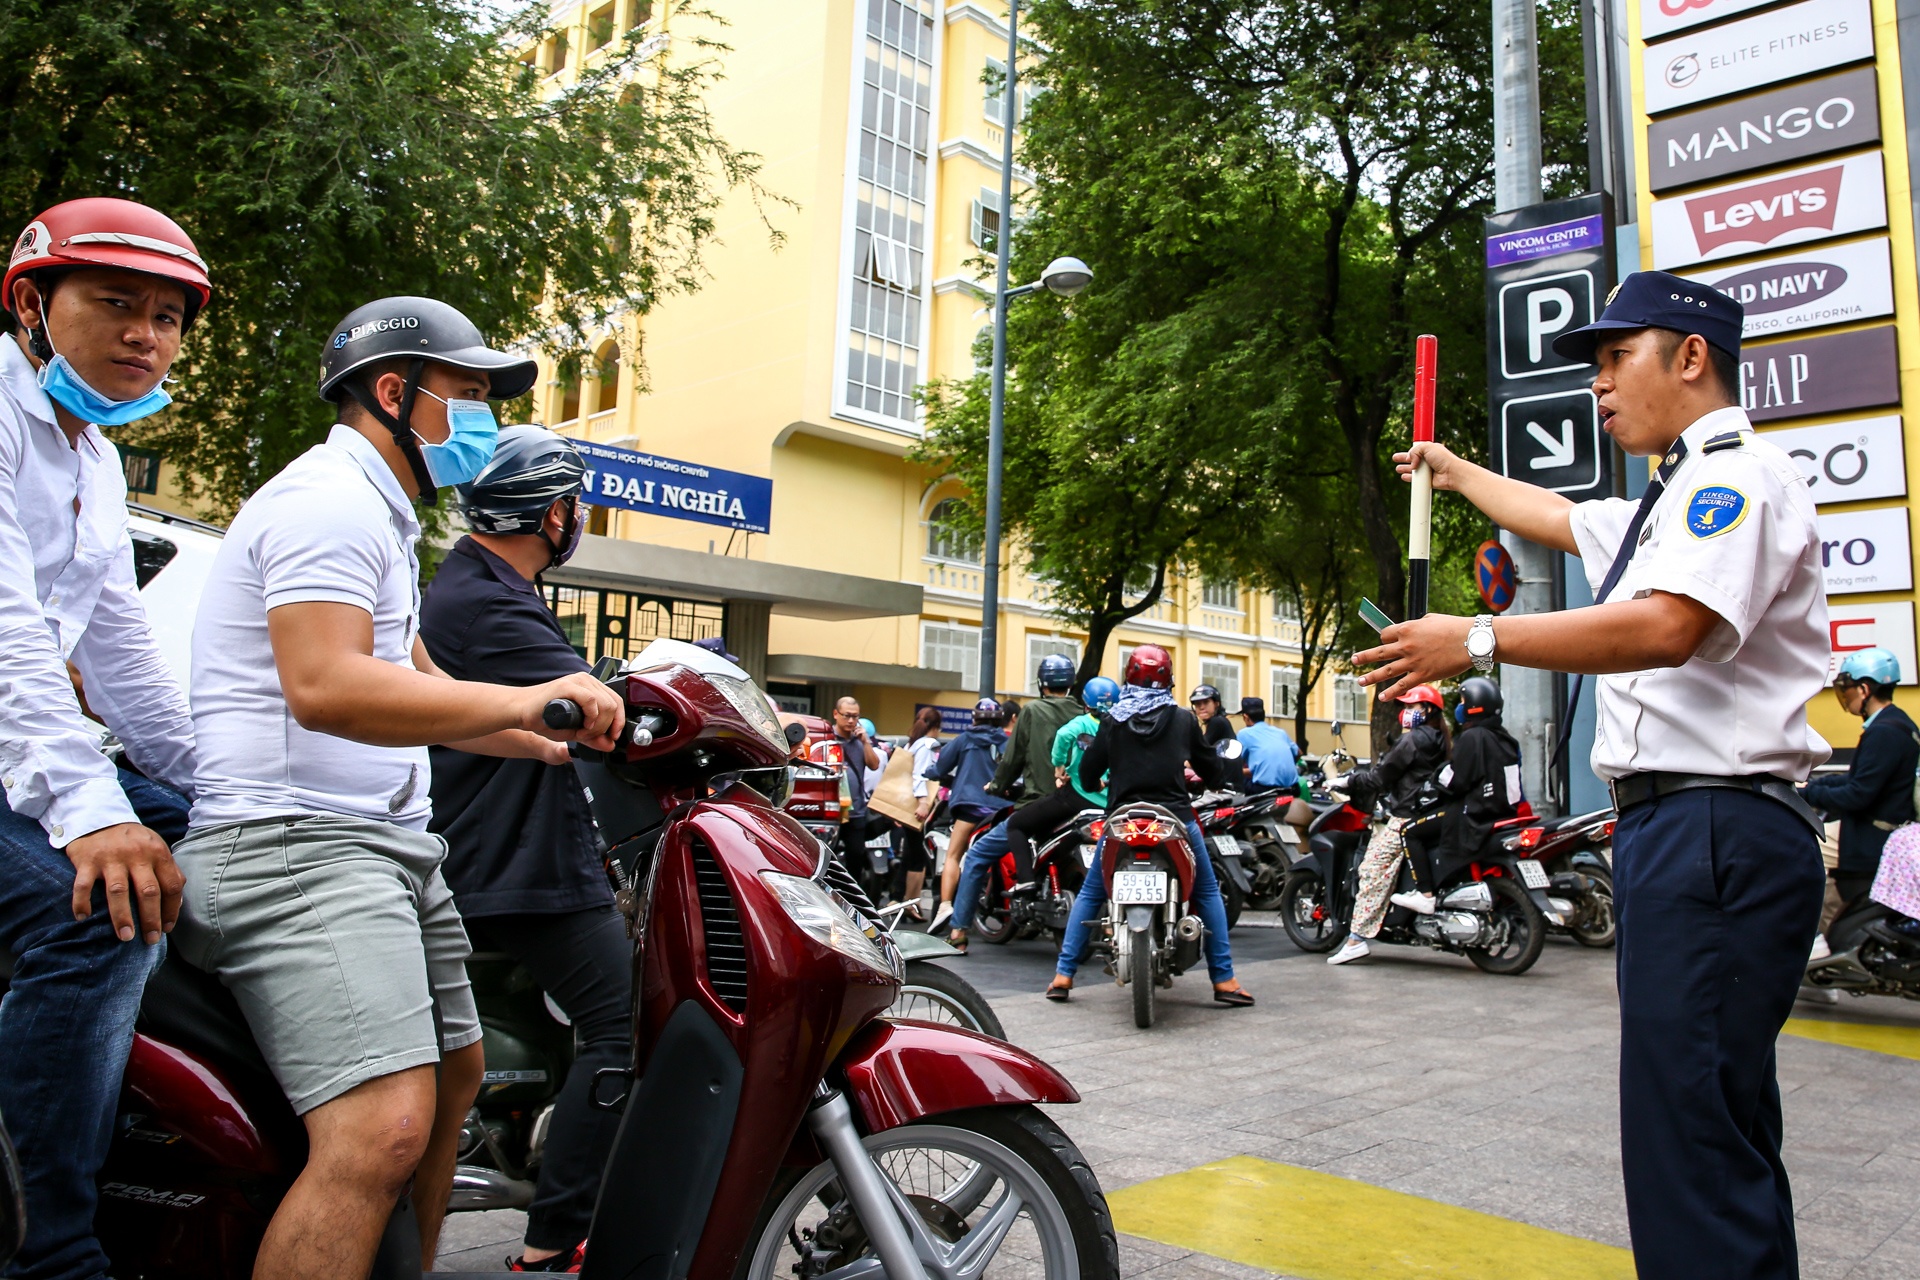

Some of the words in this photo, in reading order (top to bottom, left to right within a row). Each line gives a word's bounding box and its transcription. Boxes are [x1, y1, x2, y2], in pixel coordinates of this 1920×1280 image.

[1710, 45, 1760, 69] ELITE
[1769, 21, 1849, 53] FITNESS
[1668, 97, 1855, 167] MANGO
[1499, 235, 1545, 252] VINCOM
[1546, 226, 1589, 244] CENTER
[1761, 269, 1828, 300] NAVY
[1527, 287, 1574, 364] P
[1786, 305, 1862, 325] CALIFORNIA
[350, 317, 419, 340] PIAGGIO
[1739, 353, 1809, 412] GAP
[591, 447, 618, 460] TRUNG
[618, 453, 636, 464] HỌC
[602, 472, 656, 506] ĐẠI
[660, 484, 746, 521] NGHĨA
[1697, 499, 1735, 509] SECURITY
[1702, 492, 1738, 501] VINCOM
[486, 1071, 517, 1080] CUB
[103, 1190, 132, 1199] FUEL
[133, 1195, 192, 1208] INJECTION
